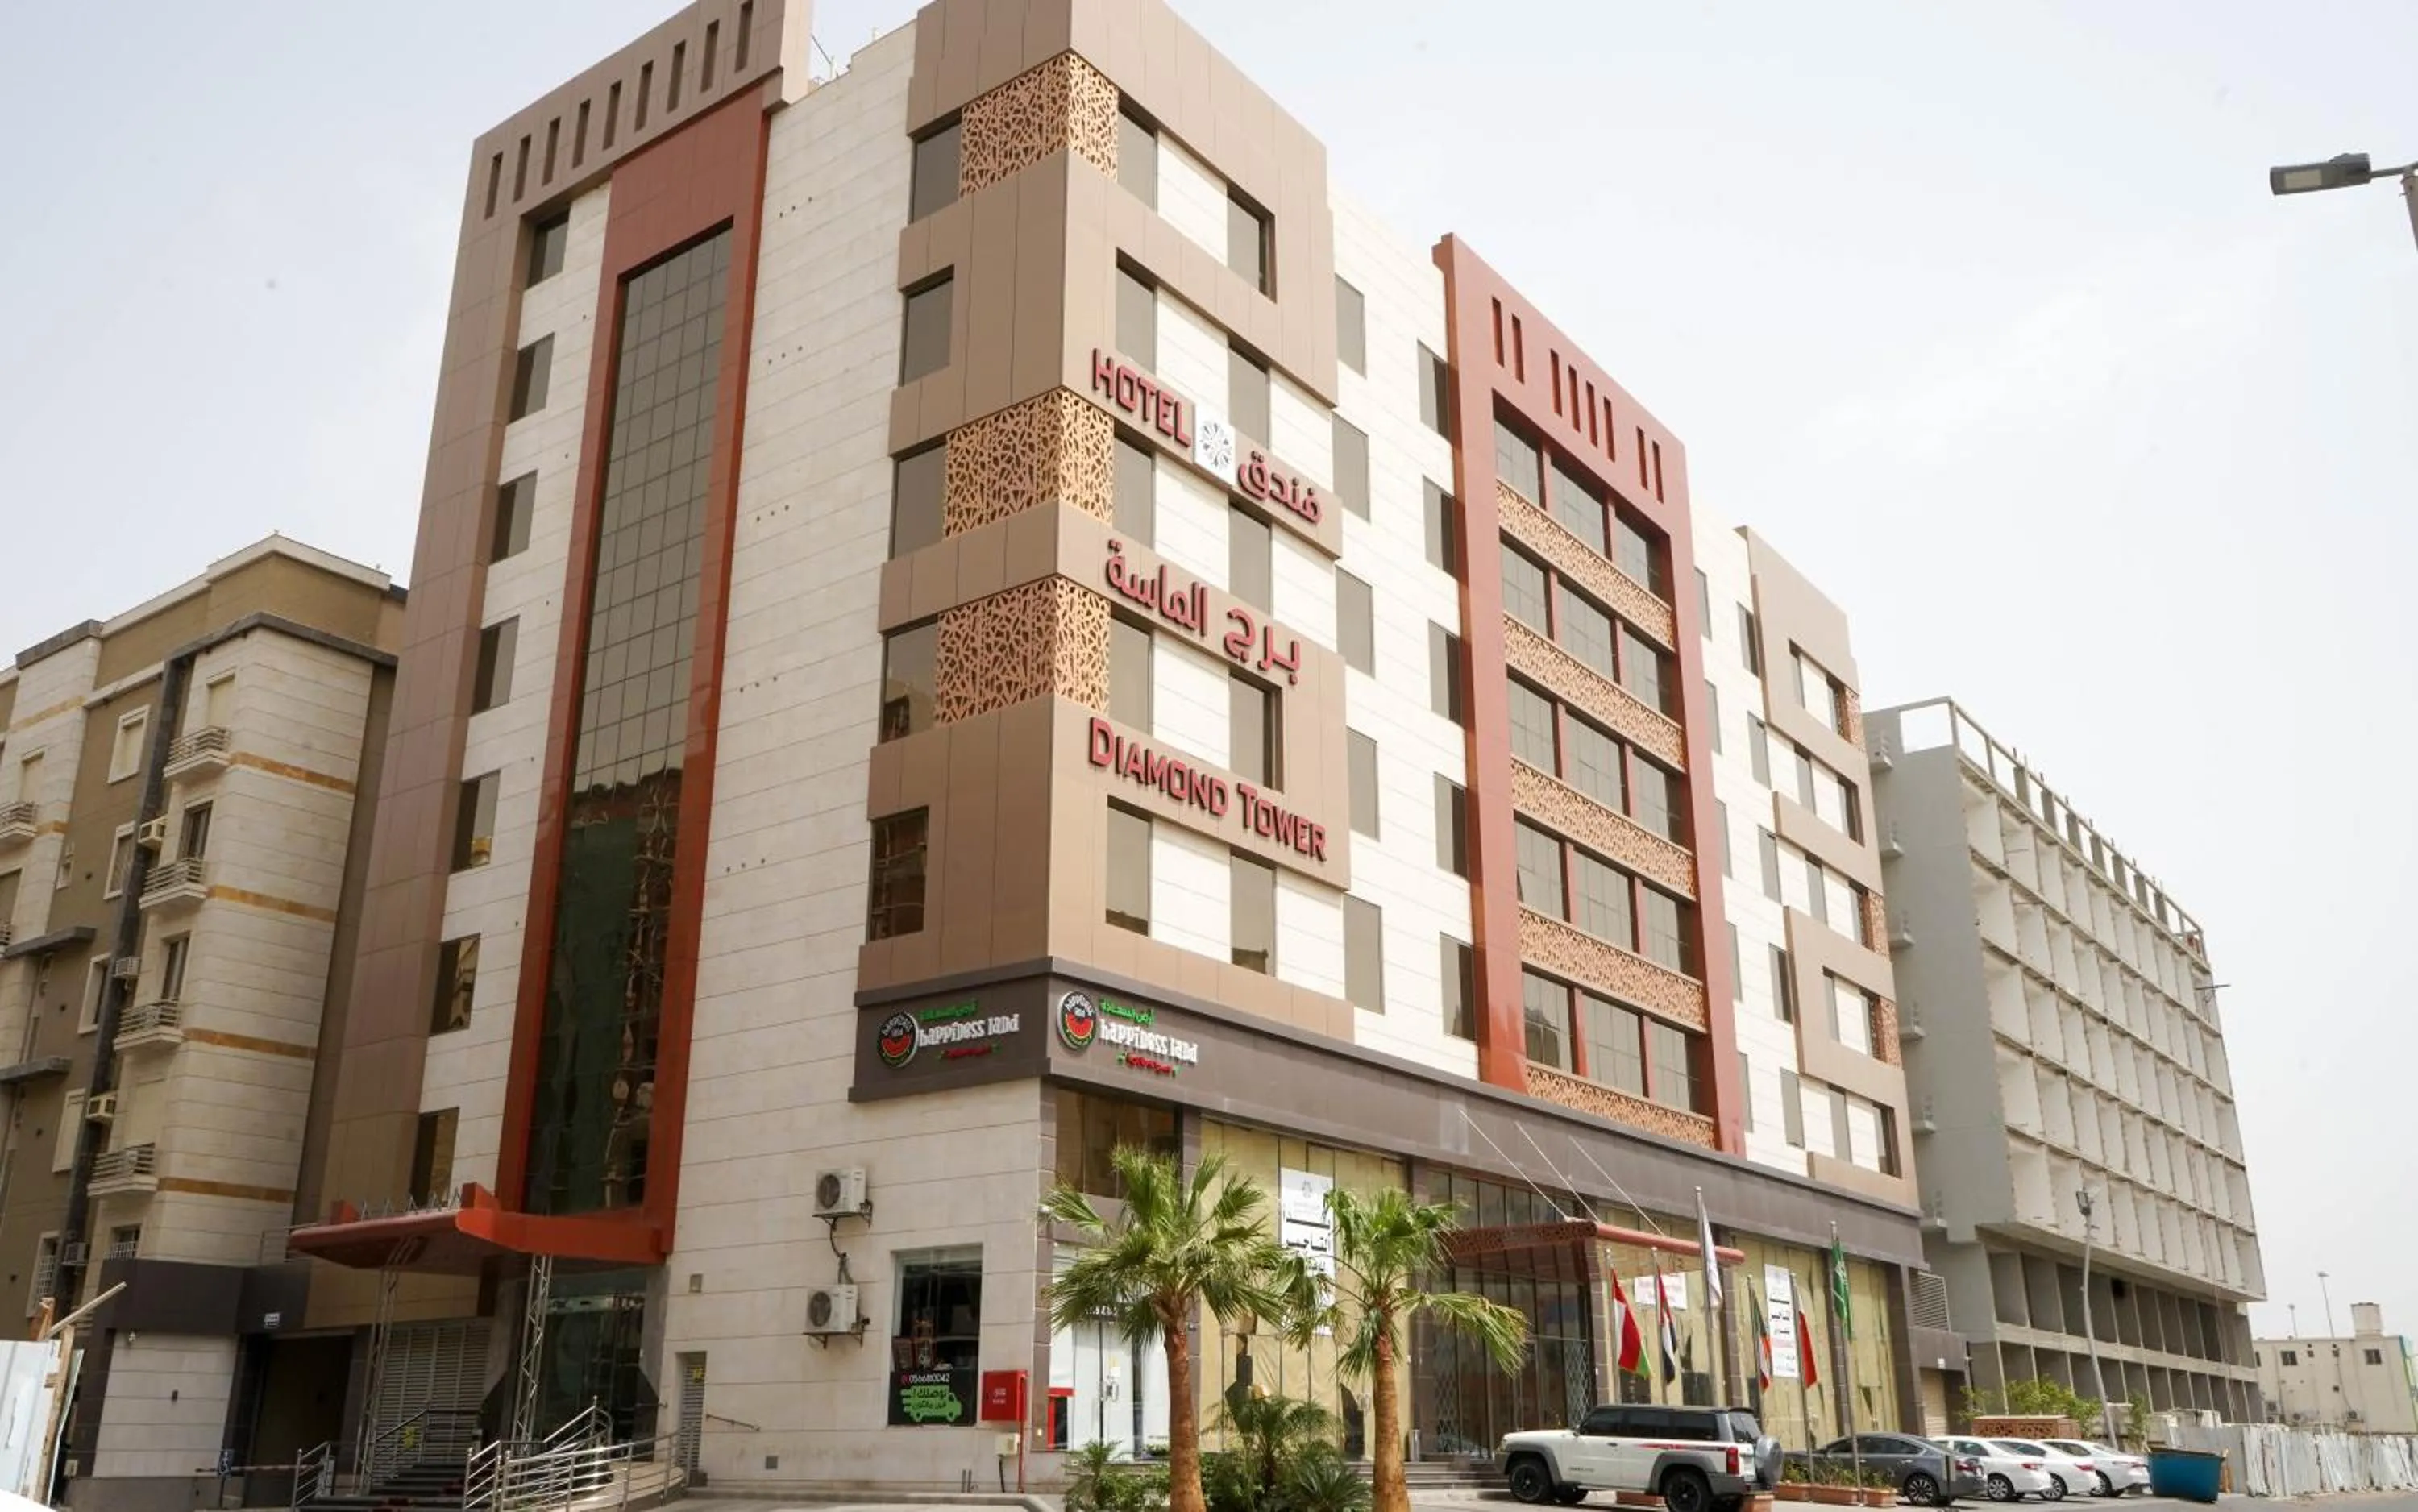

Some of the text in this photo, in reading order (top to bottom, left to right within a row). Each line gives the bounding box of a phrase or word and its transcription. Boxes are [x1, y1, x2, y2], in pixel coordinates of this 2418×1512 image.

[1092, 348, 1192, 447] HOTEL
[1237, 451, 1323, 525] فندق
[1106, 538, 1302, 685] برج الماسة
[1089, 717, 1327, 862] DIAMOND TOWER
